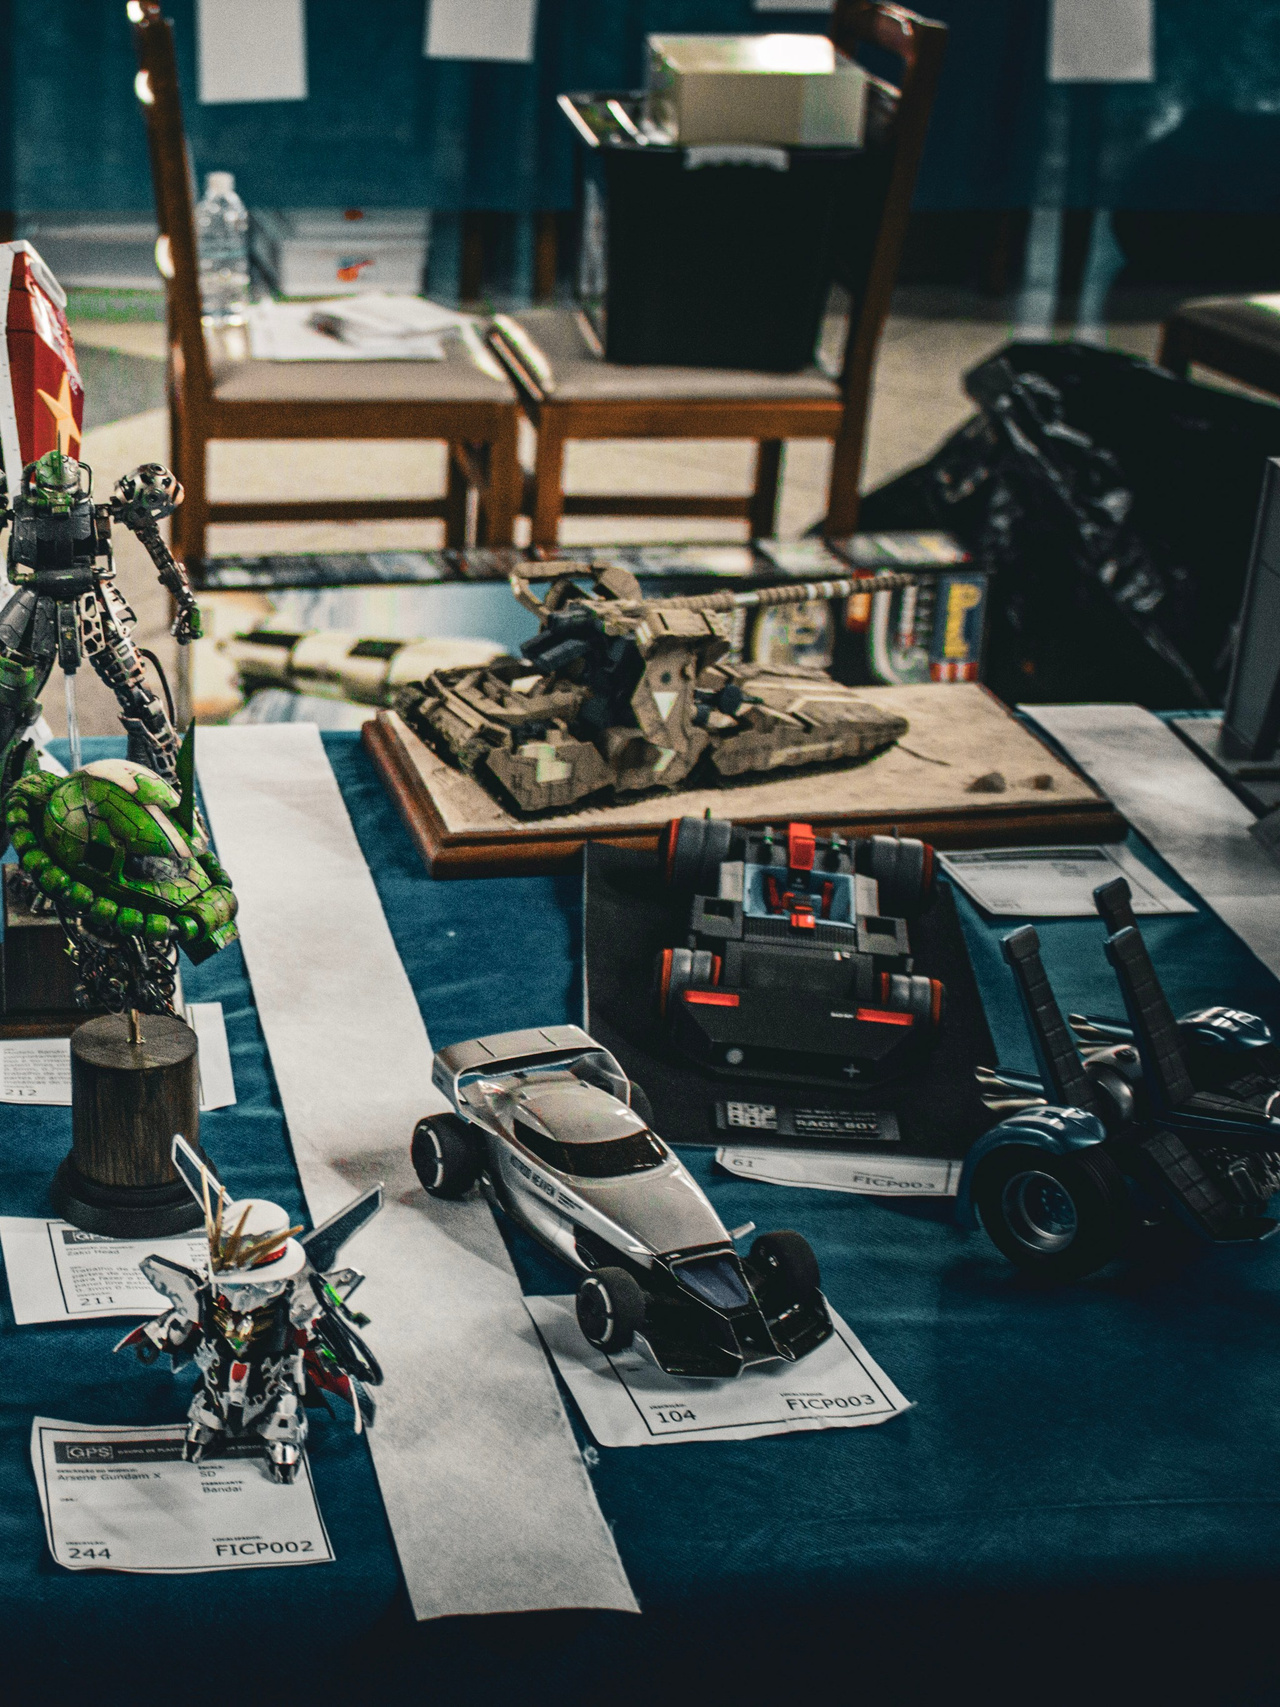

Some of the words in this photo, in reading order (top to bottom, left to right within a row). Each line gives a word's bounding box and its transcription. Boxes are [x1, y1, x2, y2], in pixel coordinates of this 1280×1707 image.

[5, 1088, 37, 1096] 212
[795, 1119, 839, 1130] RACE
[845, 1119, 879, 1131] BOY
[732, 1158, 754, 1169] 61
[852, 1174, 936, 1190] FICP003
[80, 1296, 115, 1306] 211
[785, 1393, 876, 1412] FICP003
[657, 1409, 697, 1424] 104
[68, 1446, 112, 1459] GPS
[58, 1473, 98, 1481] Arsene
[101, 1472, 150, 1481] Gundam
[200, 1469, 217, 1478] SD
[202, 1485, 242, 1494] Bandai
[68, 1547, 112, 1560] 244
[215, 1539, 315, 1557] FICP002
